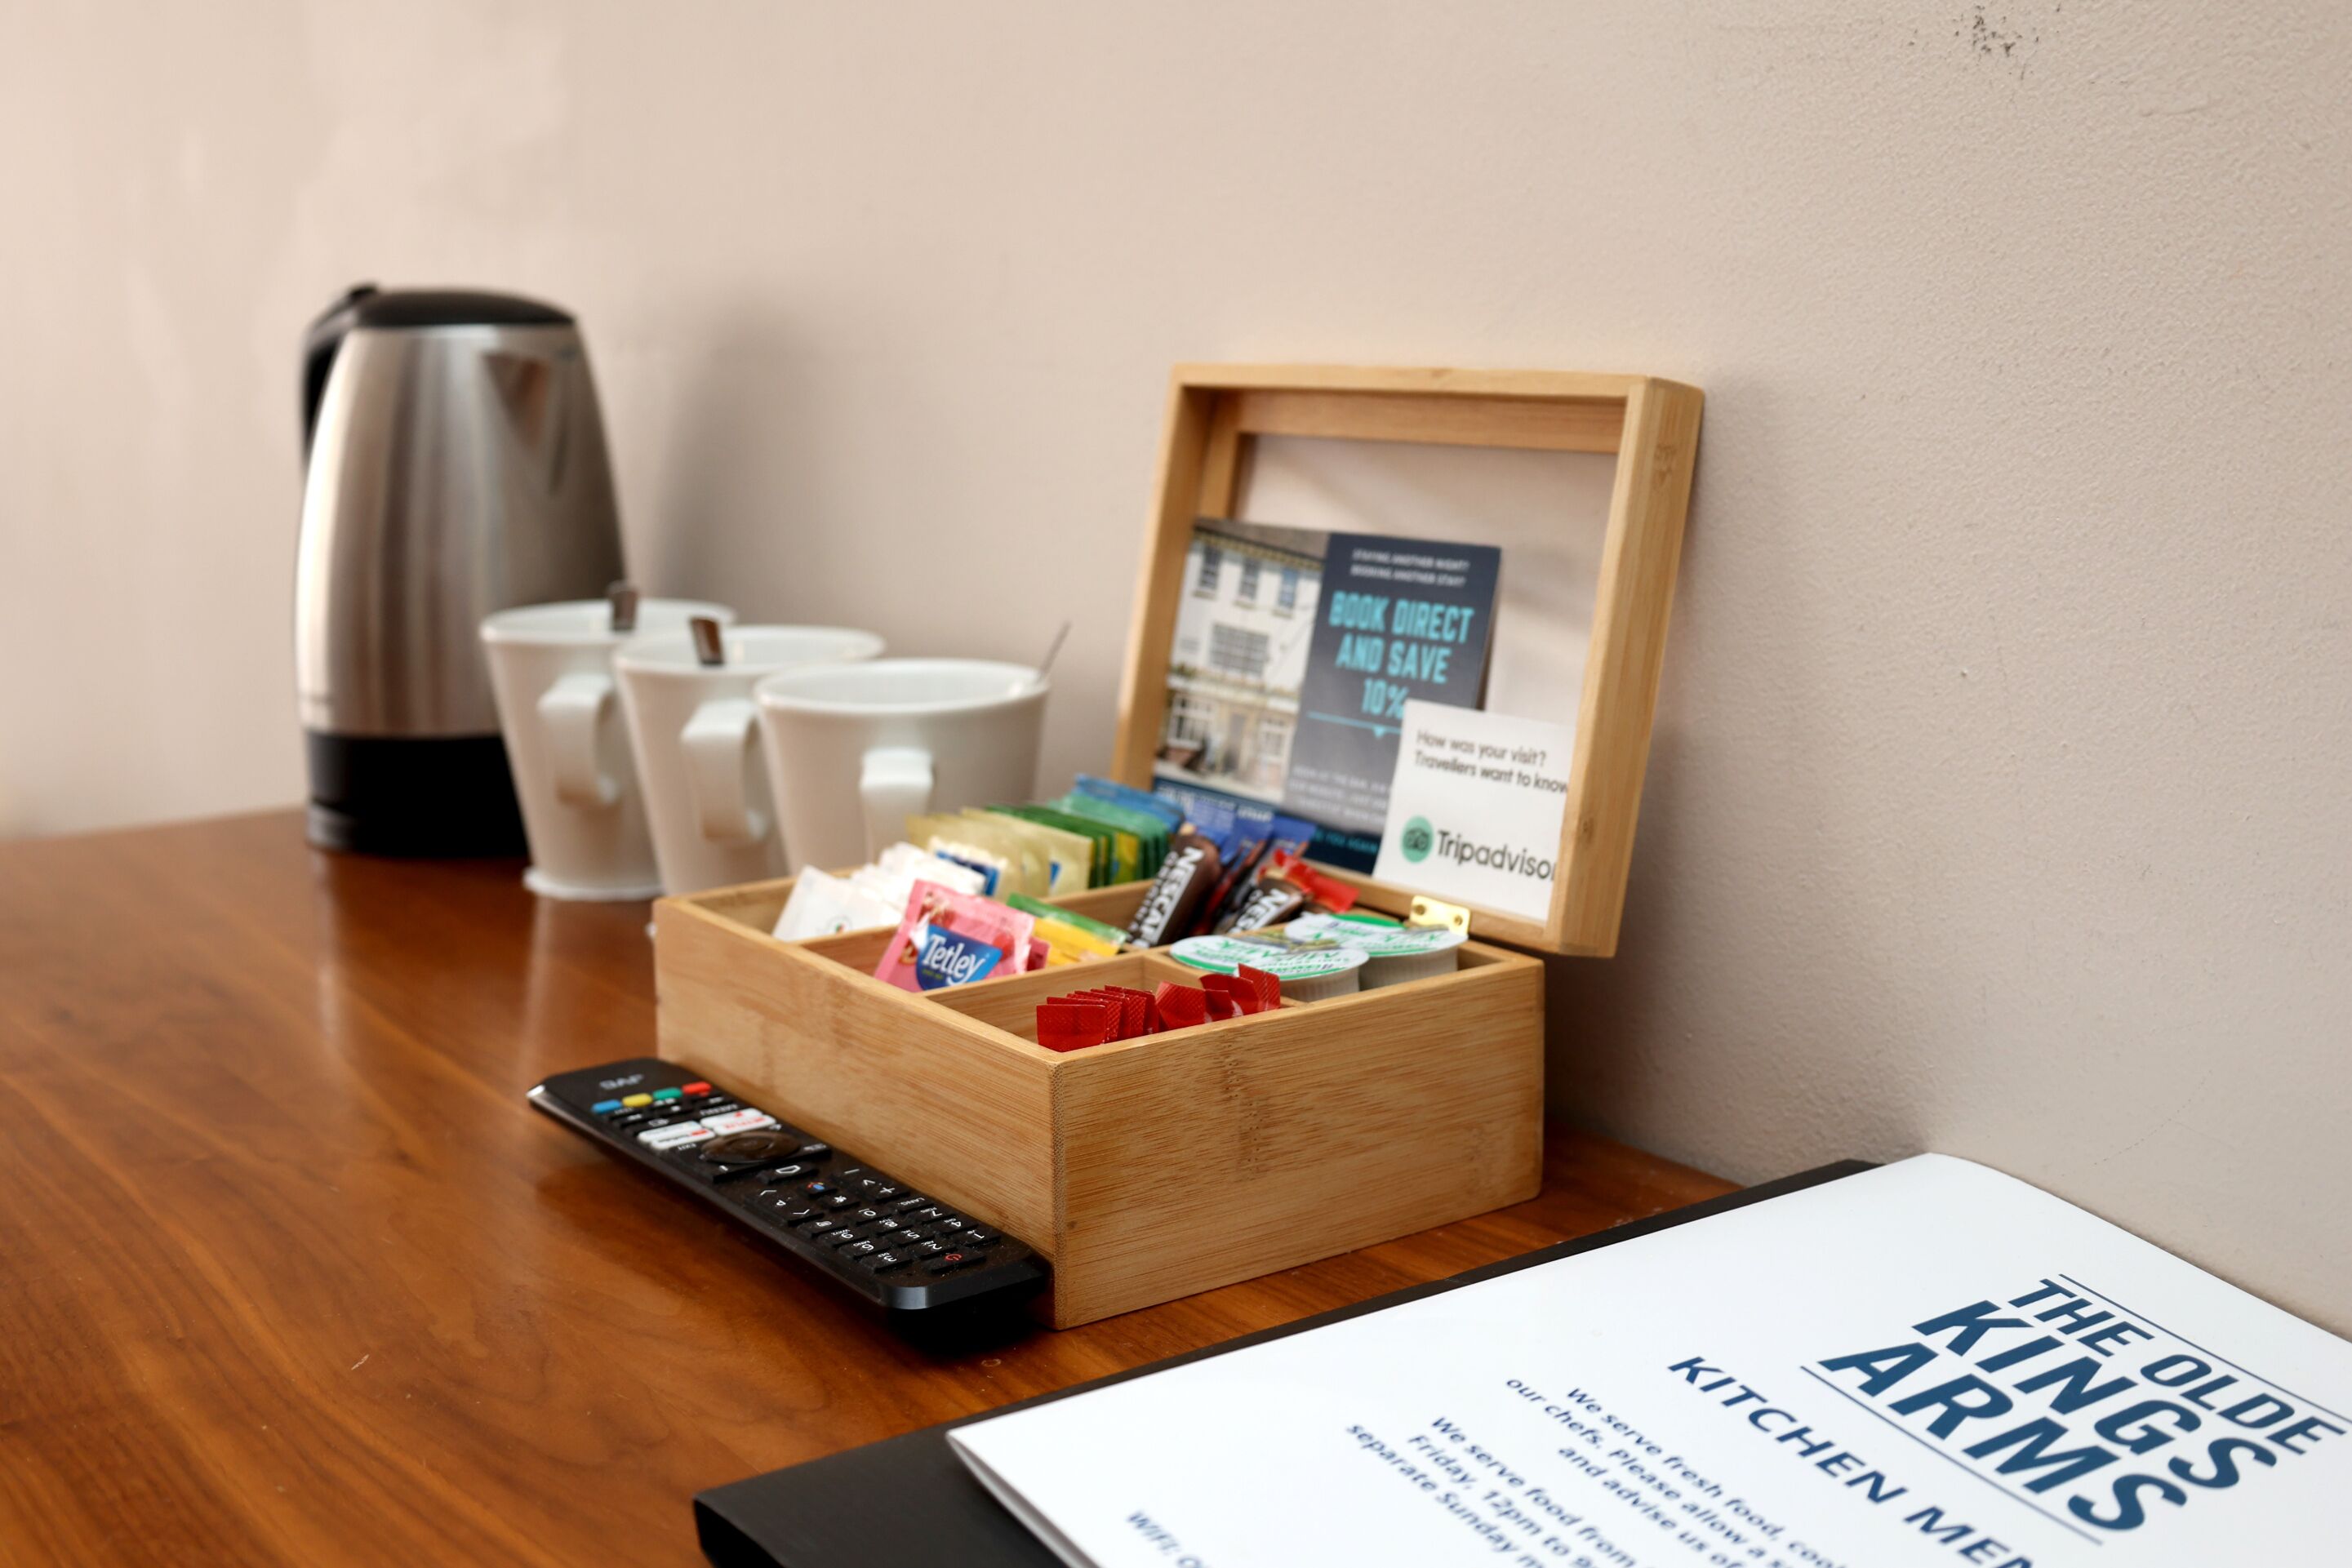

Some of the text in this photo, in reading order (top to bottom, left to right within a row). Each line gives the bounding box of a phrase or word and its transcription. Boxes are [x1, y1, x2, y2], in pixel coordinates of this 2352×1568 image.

[1328, 589, 1475, 644] BOOK DIRECT
[1334, 632, 1452, 684] AND SAVE
[1361, 677, 1410, 720] 10%
[1416, 730, 1547, 767] How was your visit?
[1415, 749, 1568, 793] Travellers want to know
[923, 934, 985, 986] Tetley
[931, 1210, 942, 1218] 7
[1911, 1299, 2278, 1489] KINGS
[2007, 1277, 2347, 1455] THE OLDE
[1346, 1424, 1438, 1492] separate
[1435, 1491, 1519, 1553] Sunday
[1407, 1434, 1478, 1489] Friday,
[1483, 1490, 1543, 1536] 12pm
[1543, 1535, 1572, 1557] to
[1431, 1416, 1636, 1568] We serve food from
[1506, 1379, 1547, 1403] our
[1545, 1404, 1603, 1450] chefs.
[1607, 1448, 1681, 1500] Please
[1681, 1501, 1749, 1545] allow
[1747, 1546, 1767, 1559] a
[1567, 1388, 1847, 1568] We serve fresh food, coo
[1667, 1356, 2034, 1568] KITCHEN ME
[1816, 1341, 2188, 1531] ARMS
[1558, 1447, 1607, 1478] and
[1603, 1479, 1678, 1530] advise
[1678, 1531, 1708, 1552] us
